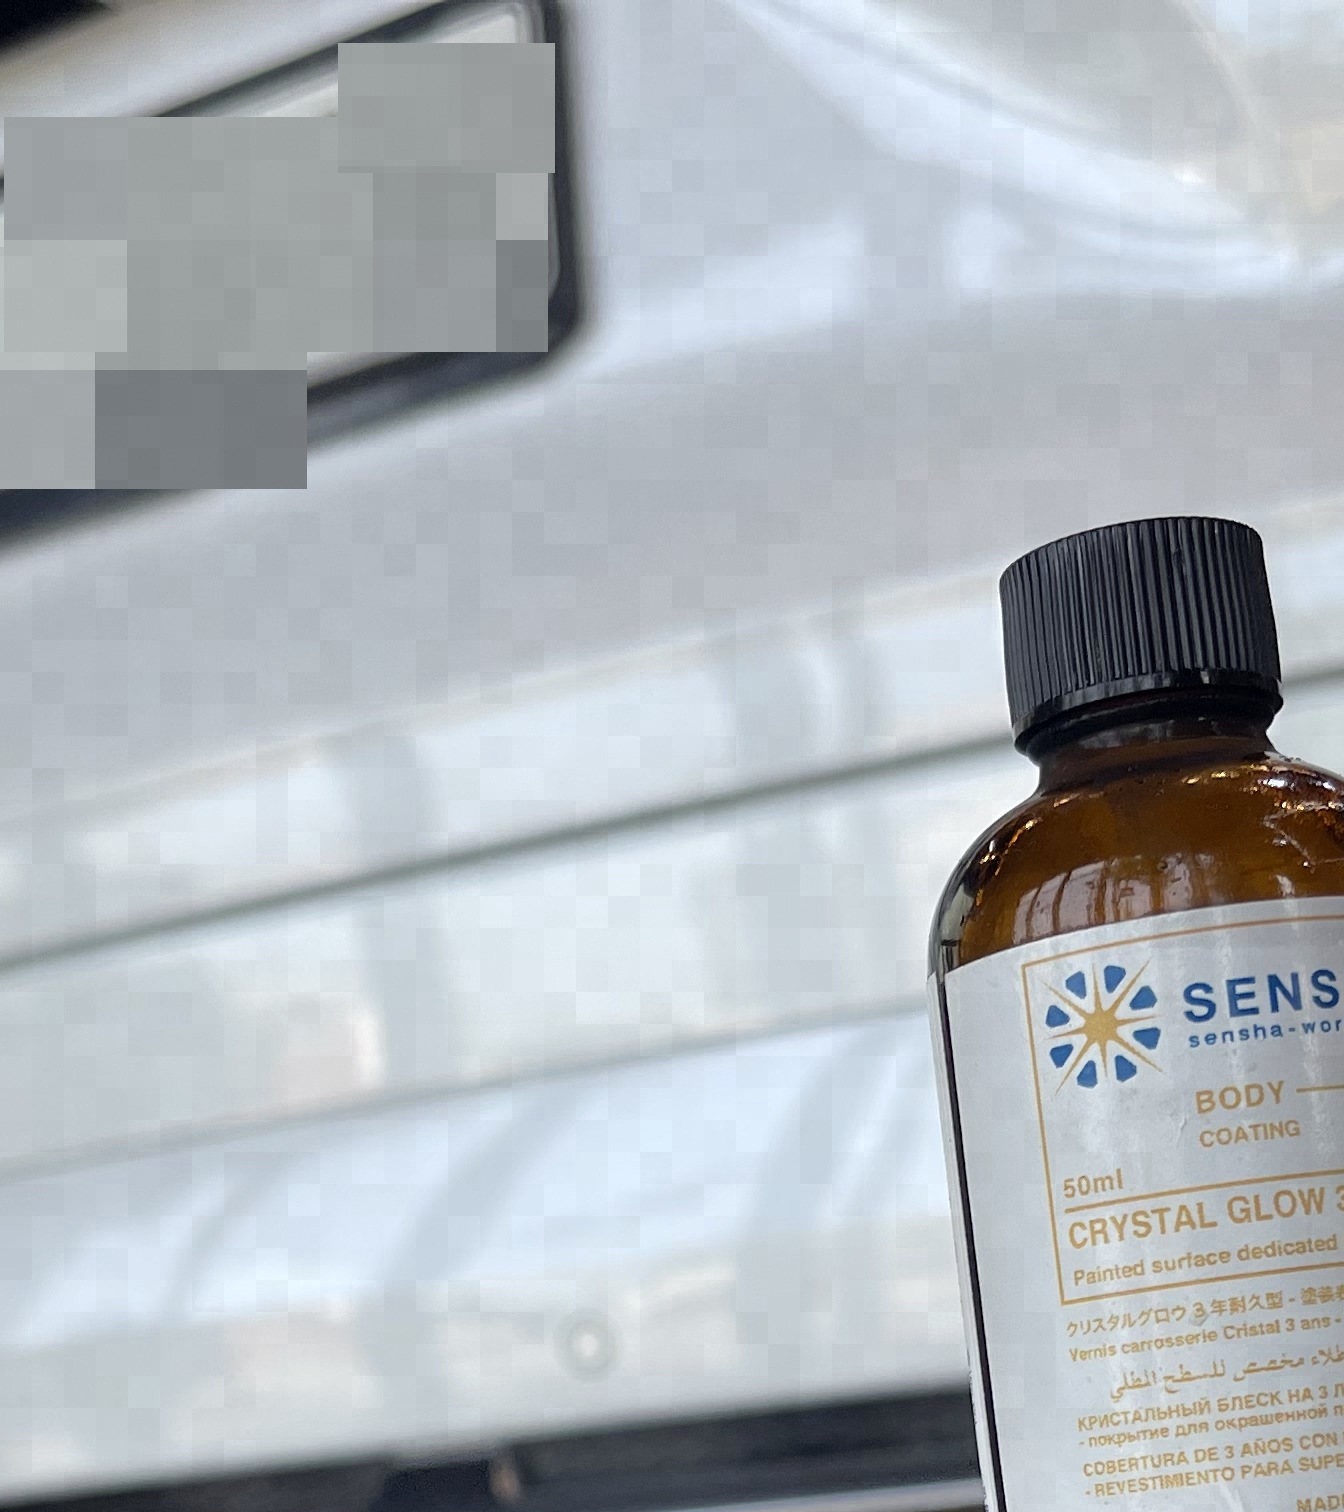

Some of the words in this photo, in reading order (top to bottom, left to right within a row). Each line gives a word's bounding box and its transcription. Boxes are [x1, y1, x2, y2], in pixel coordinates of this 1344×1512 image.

[1194, 1080, 1285, 1114] BODY
[1199, 1119, 1300, 1148] COATING
[1063, 1169, 1123, 1199] 50ml
[1068, 1200, 1217, 1249] CRYSTAL
[1227, 1187, 1325, 1226] GLOW
[1073, 1253, 1145, 1286] Painted
[1152, 1249, 1230, 1276] surface
[1237, 1234, 1337, 1266] dedicated
[1067, 1305, 1186, 1338] クリスタルグロウ
[1069, 1344, 1117, 1362] Vernis
[1121, 1329, 1218, 1354] carrosserie
[1224, 1320, 1280, 1340] Cristal
[1285, 1318, 1295, 1332] 3
[1301, 1316, 1331, 1330] ans
[1078, 1397, 1211, 1431] КРИСТАЛЬНЫЙ
[1217, 1391, 1282, 1413] БЛЕСК
[1288, 1387, 1313, 1404] НА
[1319, 1385, 1328, 1398] 3
[1089, 1426, 1169, 1448] покрытие
[1175, 1422, 1208, 1438] для
[1215, 1403, 1328, 1432] окрашенной
[1083, 1451, 1189, 1477] COBERTURA
[1195, 1447, 1219, 1464] DE
[1225, 1446, 1234, 1459] 3
[1240, 1437, 1294, 1457] AÑOS
[1299, 1432, 1338, 1450] CON
[1095, 1466, 1235, 1497] REVESTIMIENTO
[1241, 1460, 1294, 1480] PARA
